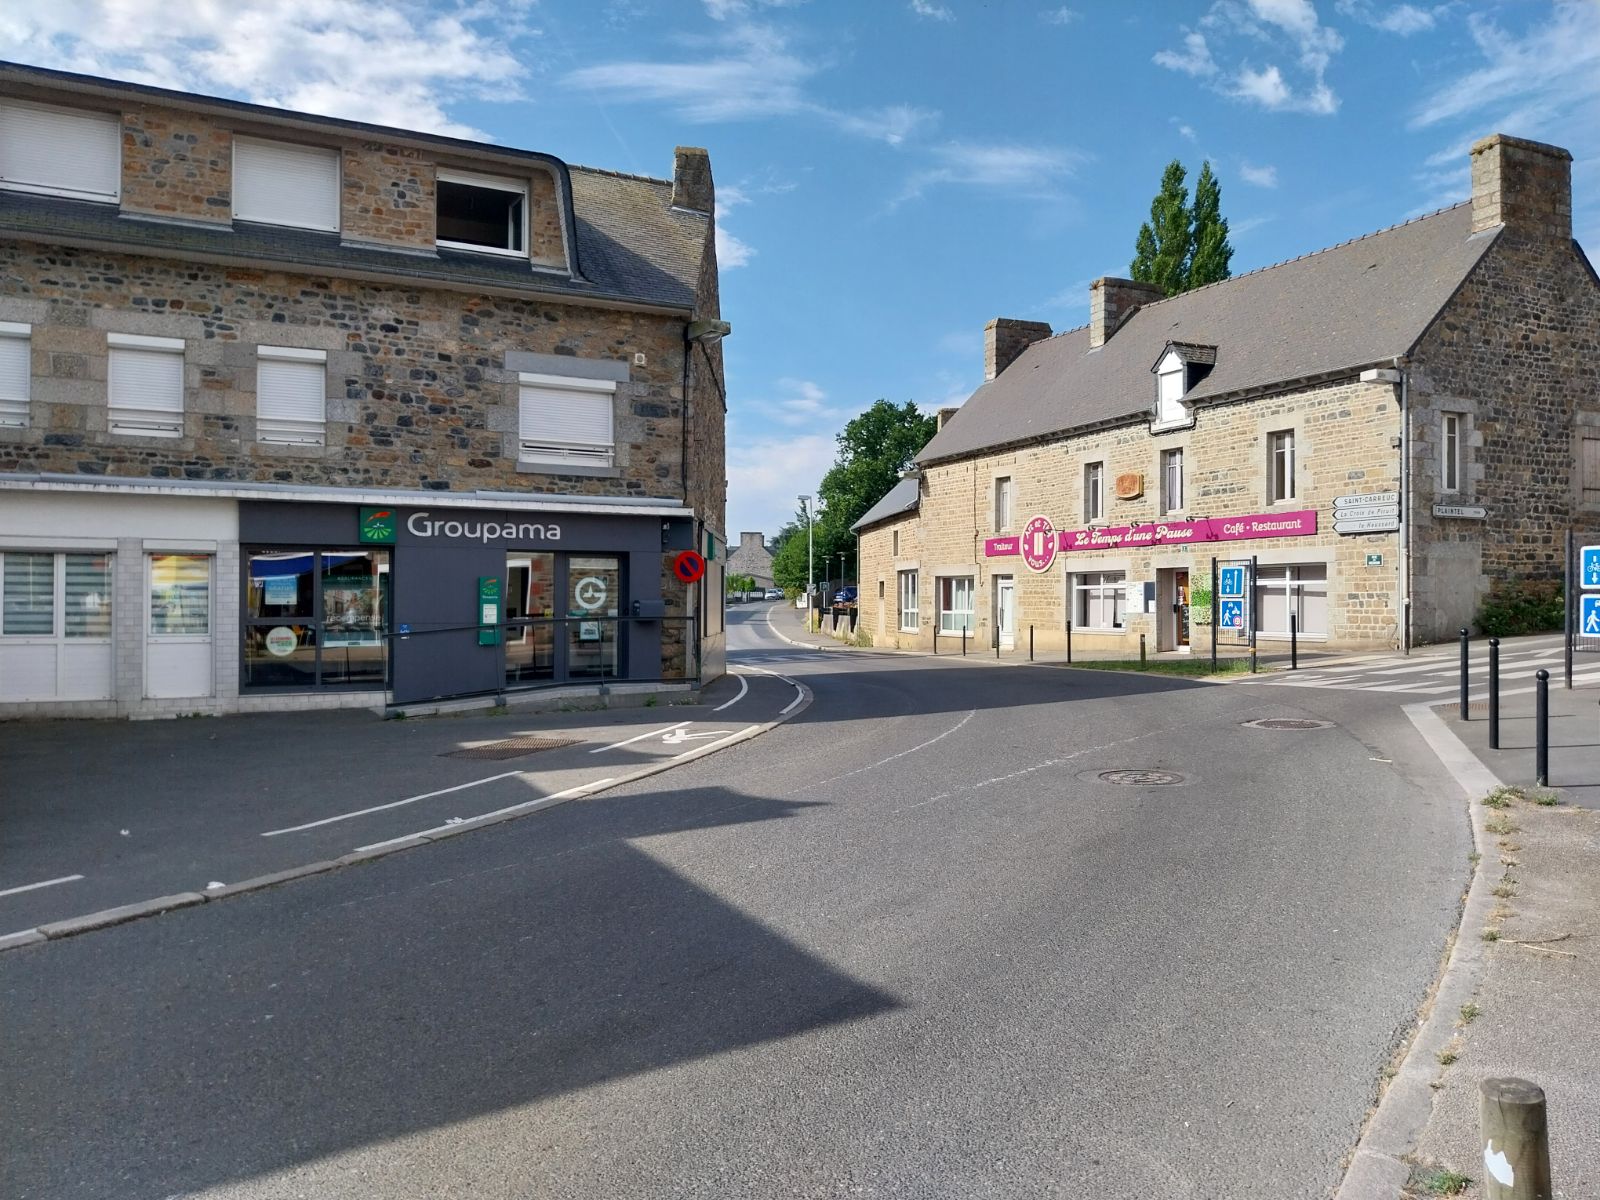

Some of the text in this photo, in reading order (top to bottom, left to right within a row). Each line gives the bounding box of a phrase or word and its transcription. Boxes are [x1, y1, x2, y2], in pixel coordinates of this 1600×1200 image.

[1344, 494, 1396, 505] SAINT-CARREUC
[1437, 507, 1464, 516] PLAINTEL
[407, 512, 561, 544] Groupama
[1223, 519, 1302, 536] Café Restaurant
[1075, 525, 1194, 547] Le Temps d'une Pause
[993, 542, 1013, 551] Traiteur
